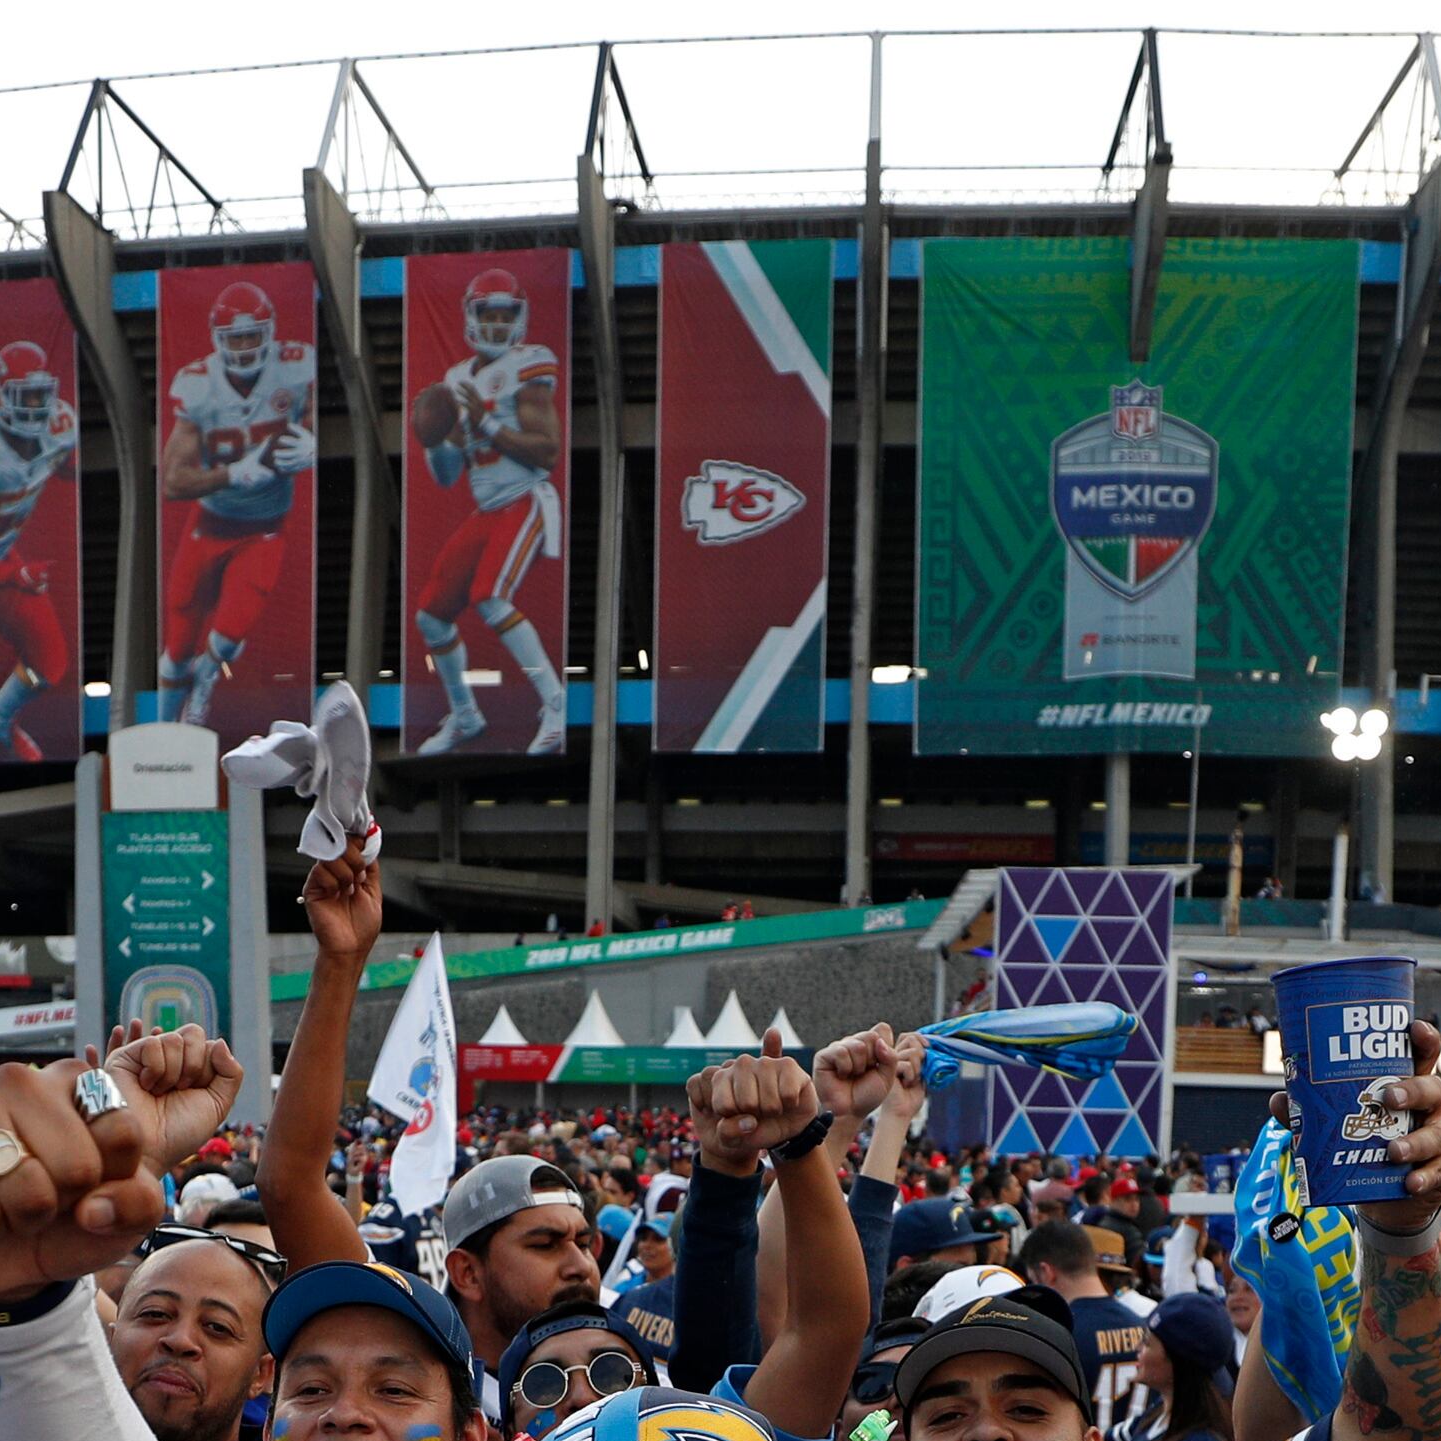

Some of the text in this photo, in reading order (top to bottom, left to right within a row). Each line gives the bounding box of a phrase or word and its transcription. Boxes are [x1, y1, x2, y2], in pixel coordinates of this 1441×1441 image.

[1117, 408, 1153, 434] NFL
[1070, 485, 1196, 511] MEXICO
[1110, 513, 1157, 525] GAME
[1102, 633, 1181, 648] BANORTE
[132, 762, 194, 775] Orientación
[525, 927, 736, 968] 2019 NFL MEXICO GAME
[14, 1005, 76, 1027] #NFLME
[1342, 1004, 1410, 1034] BUD
[1332, 1147, 1392, 1166] CHAR
[1345, 1174, 1383, 1187] EDICIÓN
[626, 1306, 676, 1347] RIVERS
